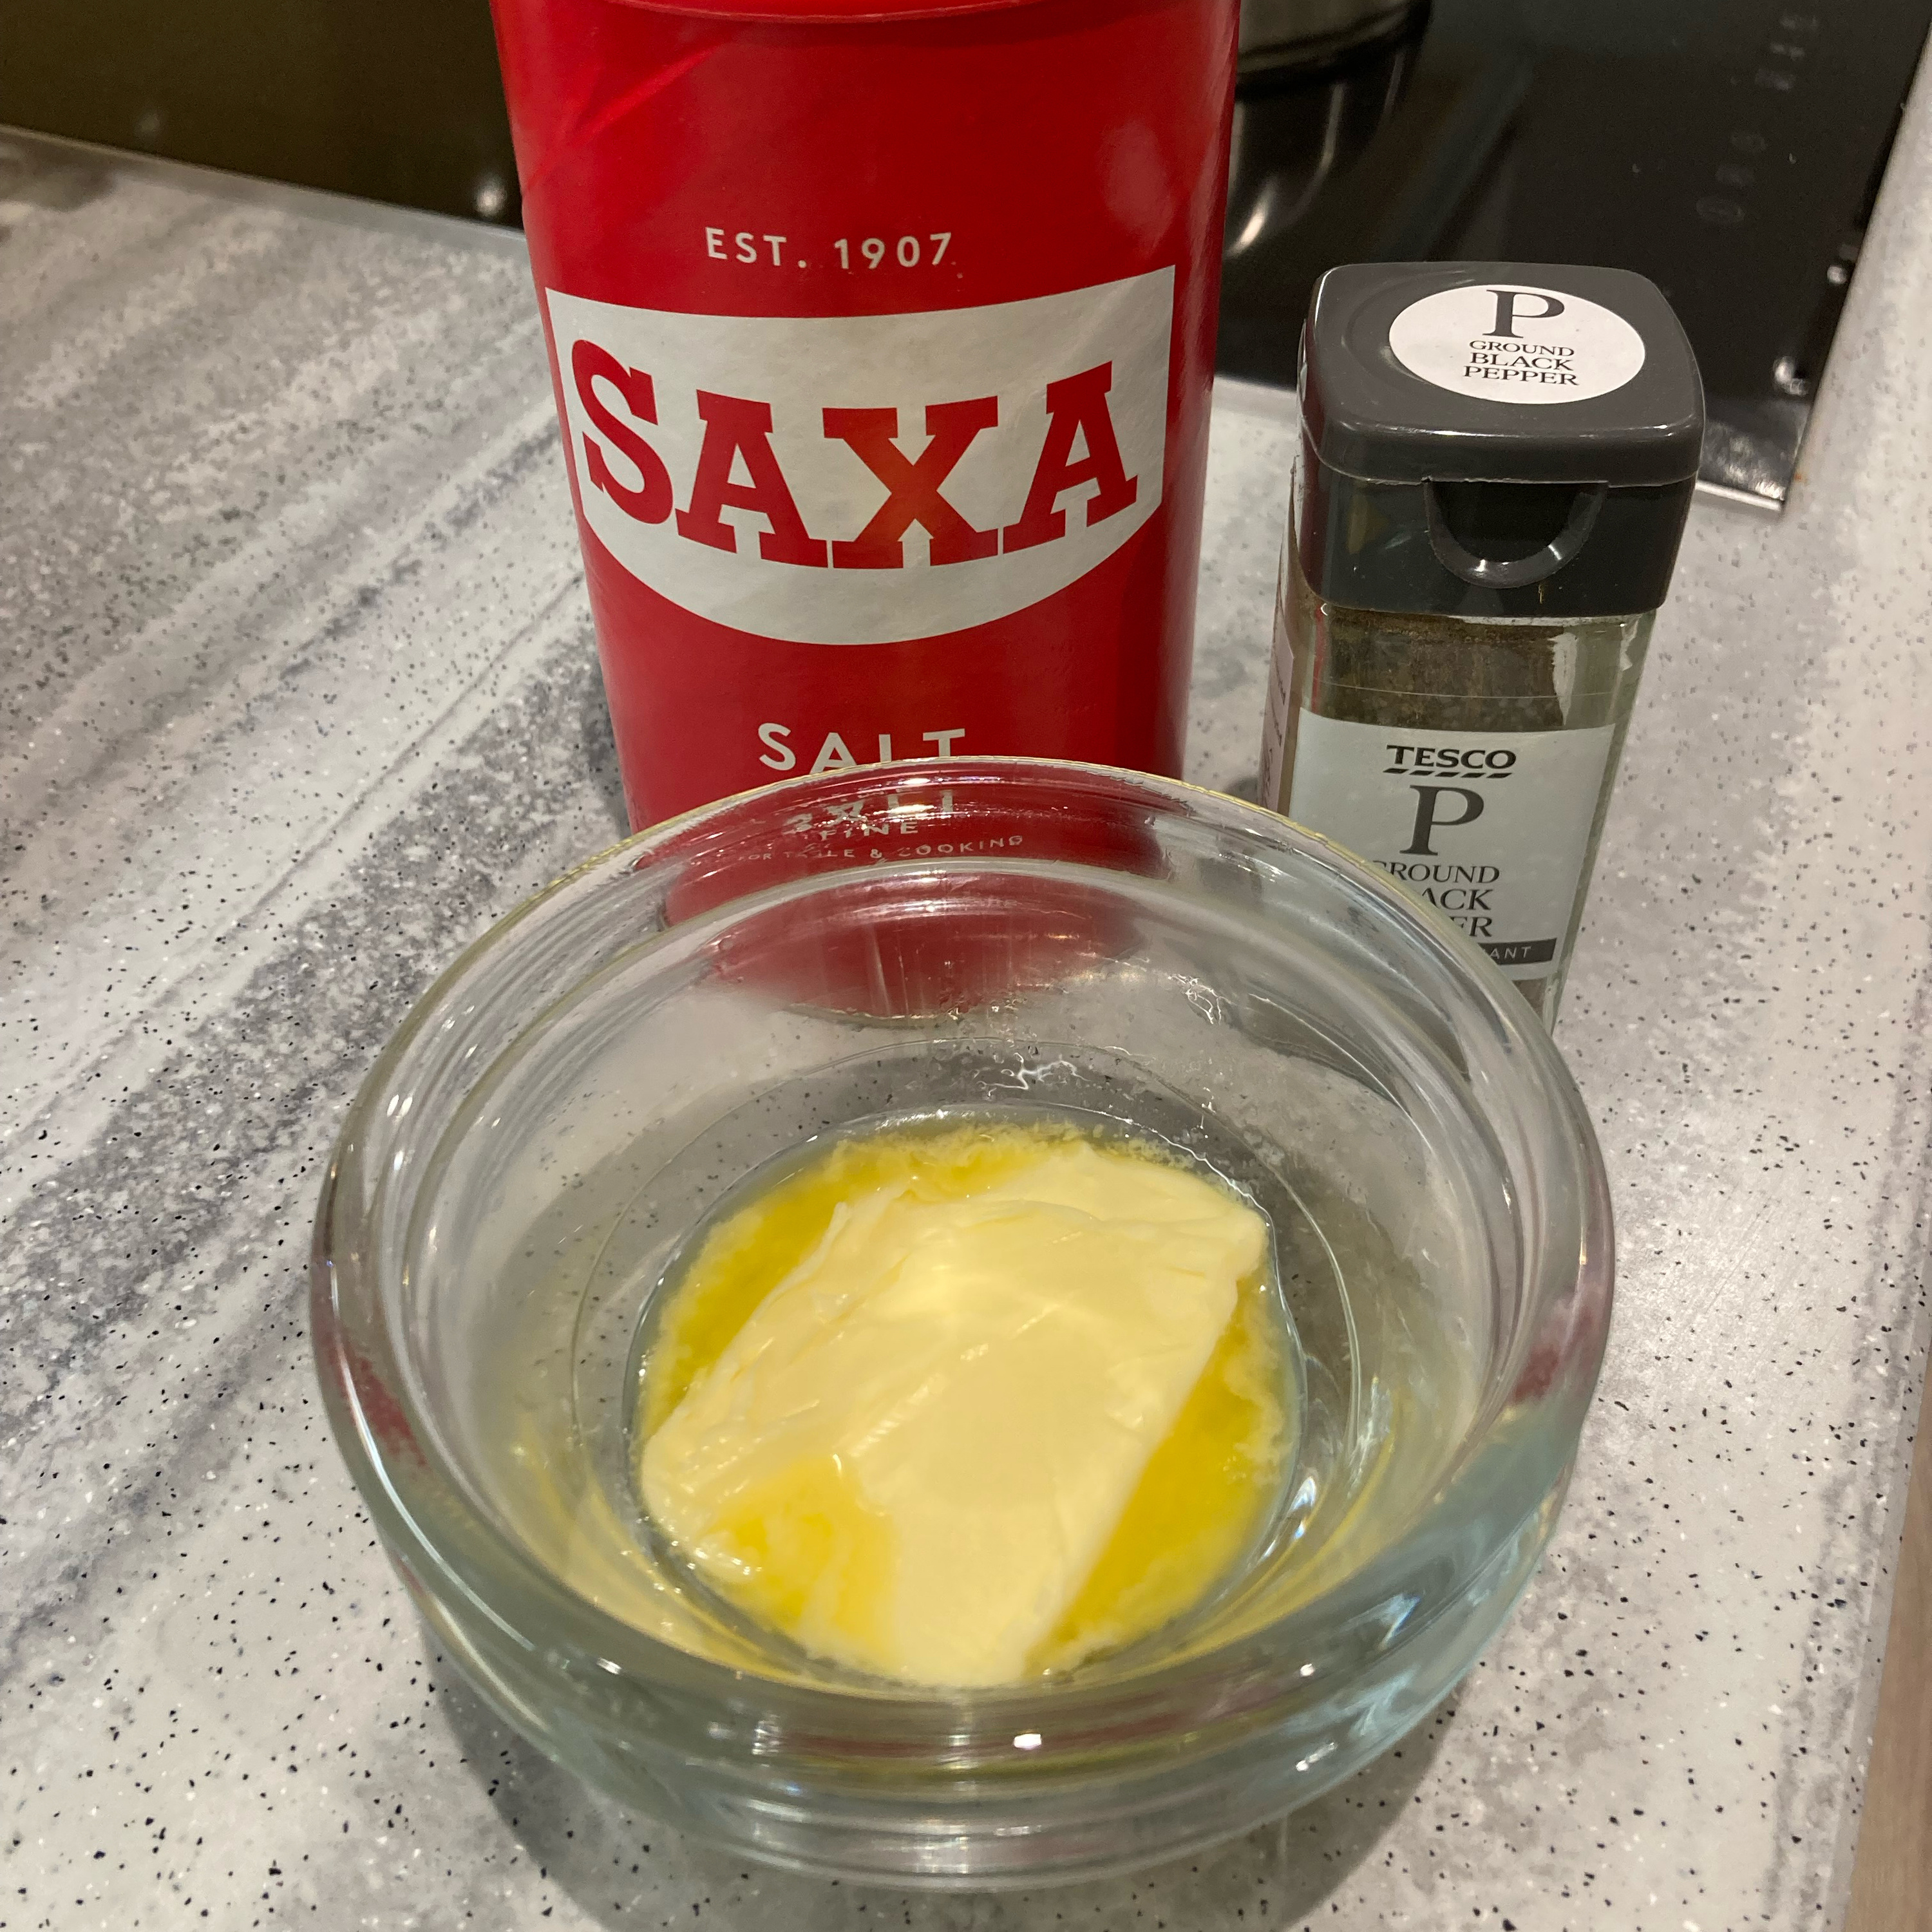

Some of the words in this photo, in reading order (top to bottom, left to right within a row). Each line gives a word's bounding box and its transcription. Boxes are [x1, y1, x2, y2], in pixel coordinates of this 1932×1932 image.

[705, 227, 808, 269] EST.
[834, 231, 953, 270] 1907
[1482, 289, 1565, 339] P
[1469, 340, 1575, 357] GROUND
[1469, 352, 1575, 371] BLACK
[1463, 366, 1580, 386] PEPPER
[571, 339, 1139, 569] SAXA
[1386, 744, 1517, 769] TESCO
[1399, 784, 1485, 857] P
